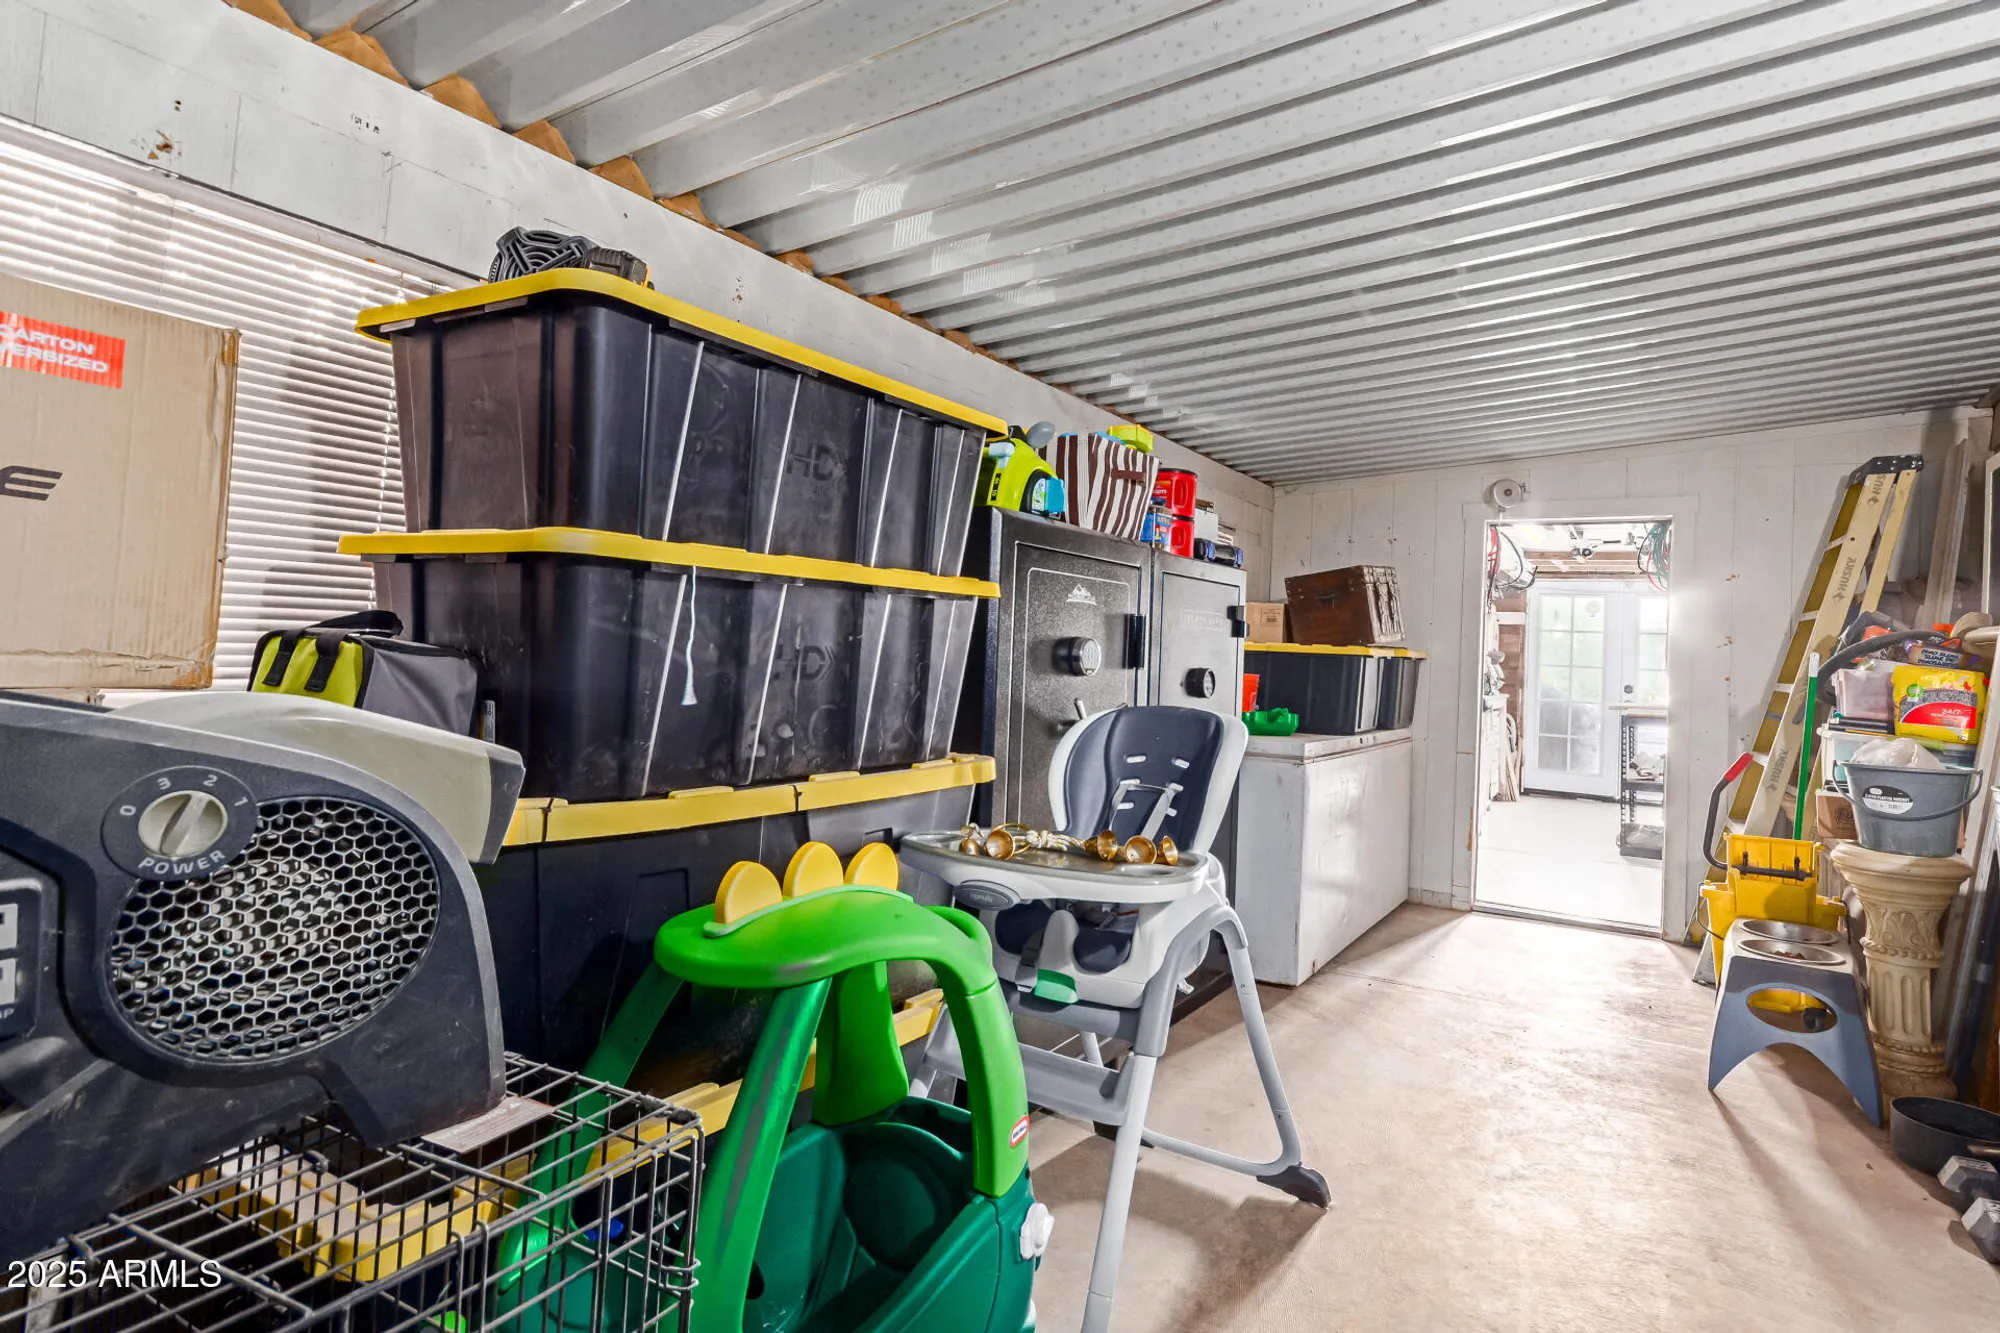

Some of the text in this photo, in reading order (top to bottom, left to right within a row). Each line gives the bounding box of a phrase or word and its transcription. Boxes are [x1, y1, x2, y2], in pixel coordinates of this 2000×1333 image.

[1837, 556, 1857, 591] HUSKY
[120, 774, 249, 816] 0 3 2 1
[138, 850, 226, 875] POWER
